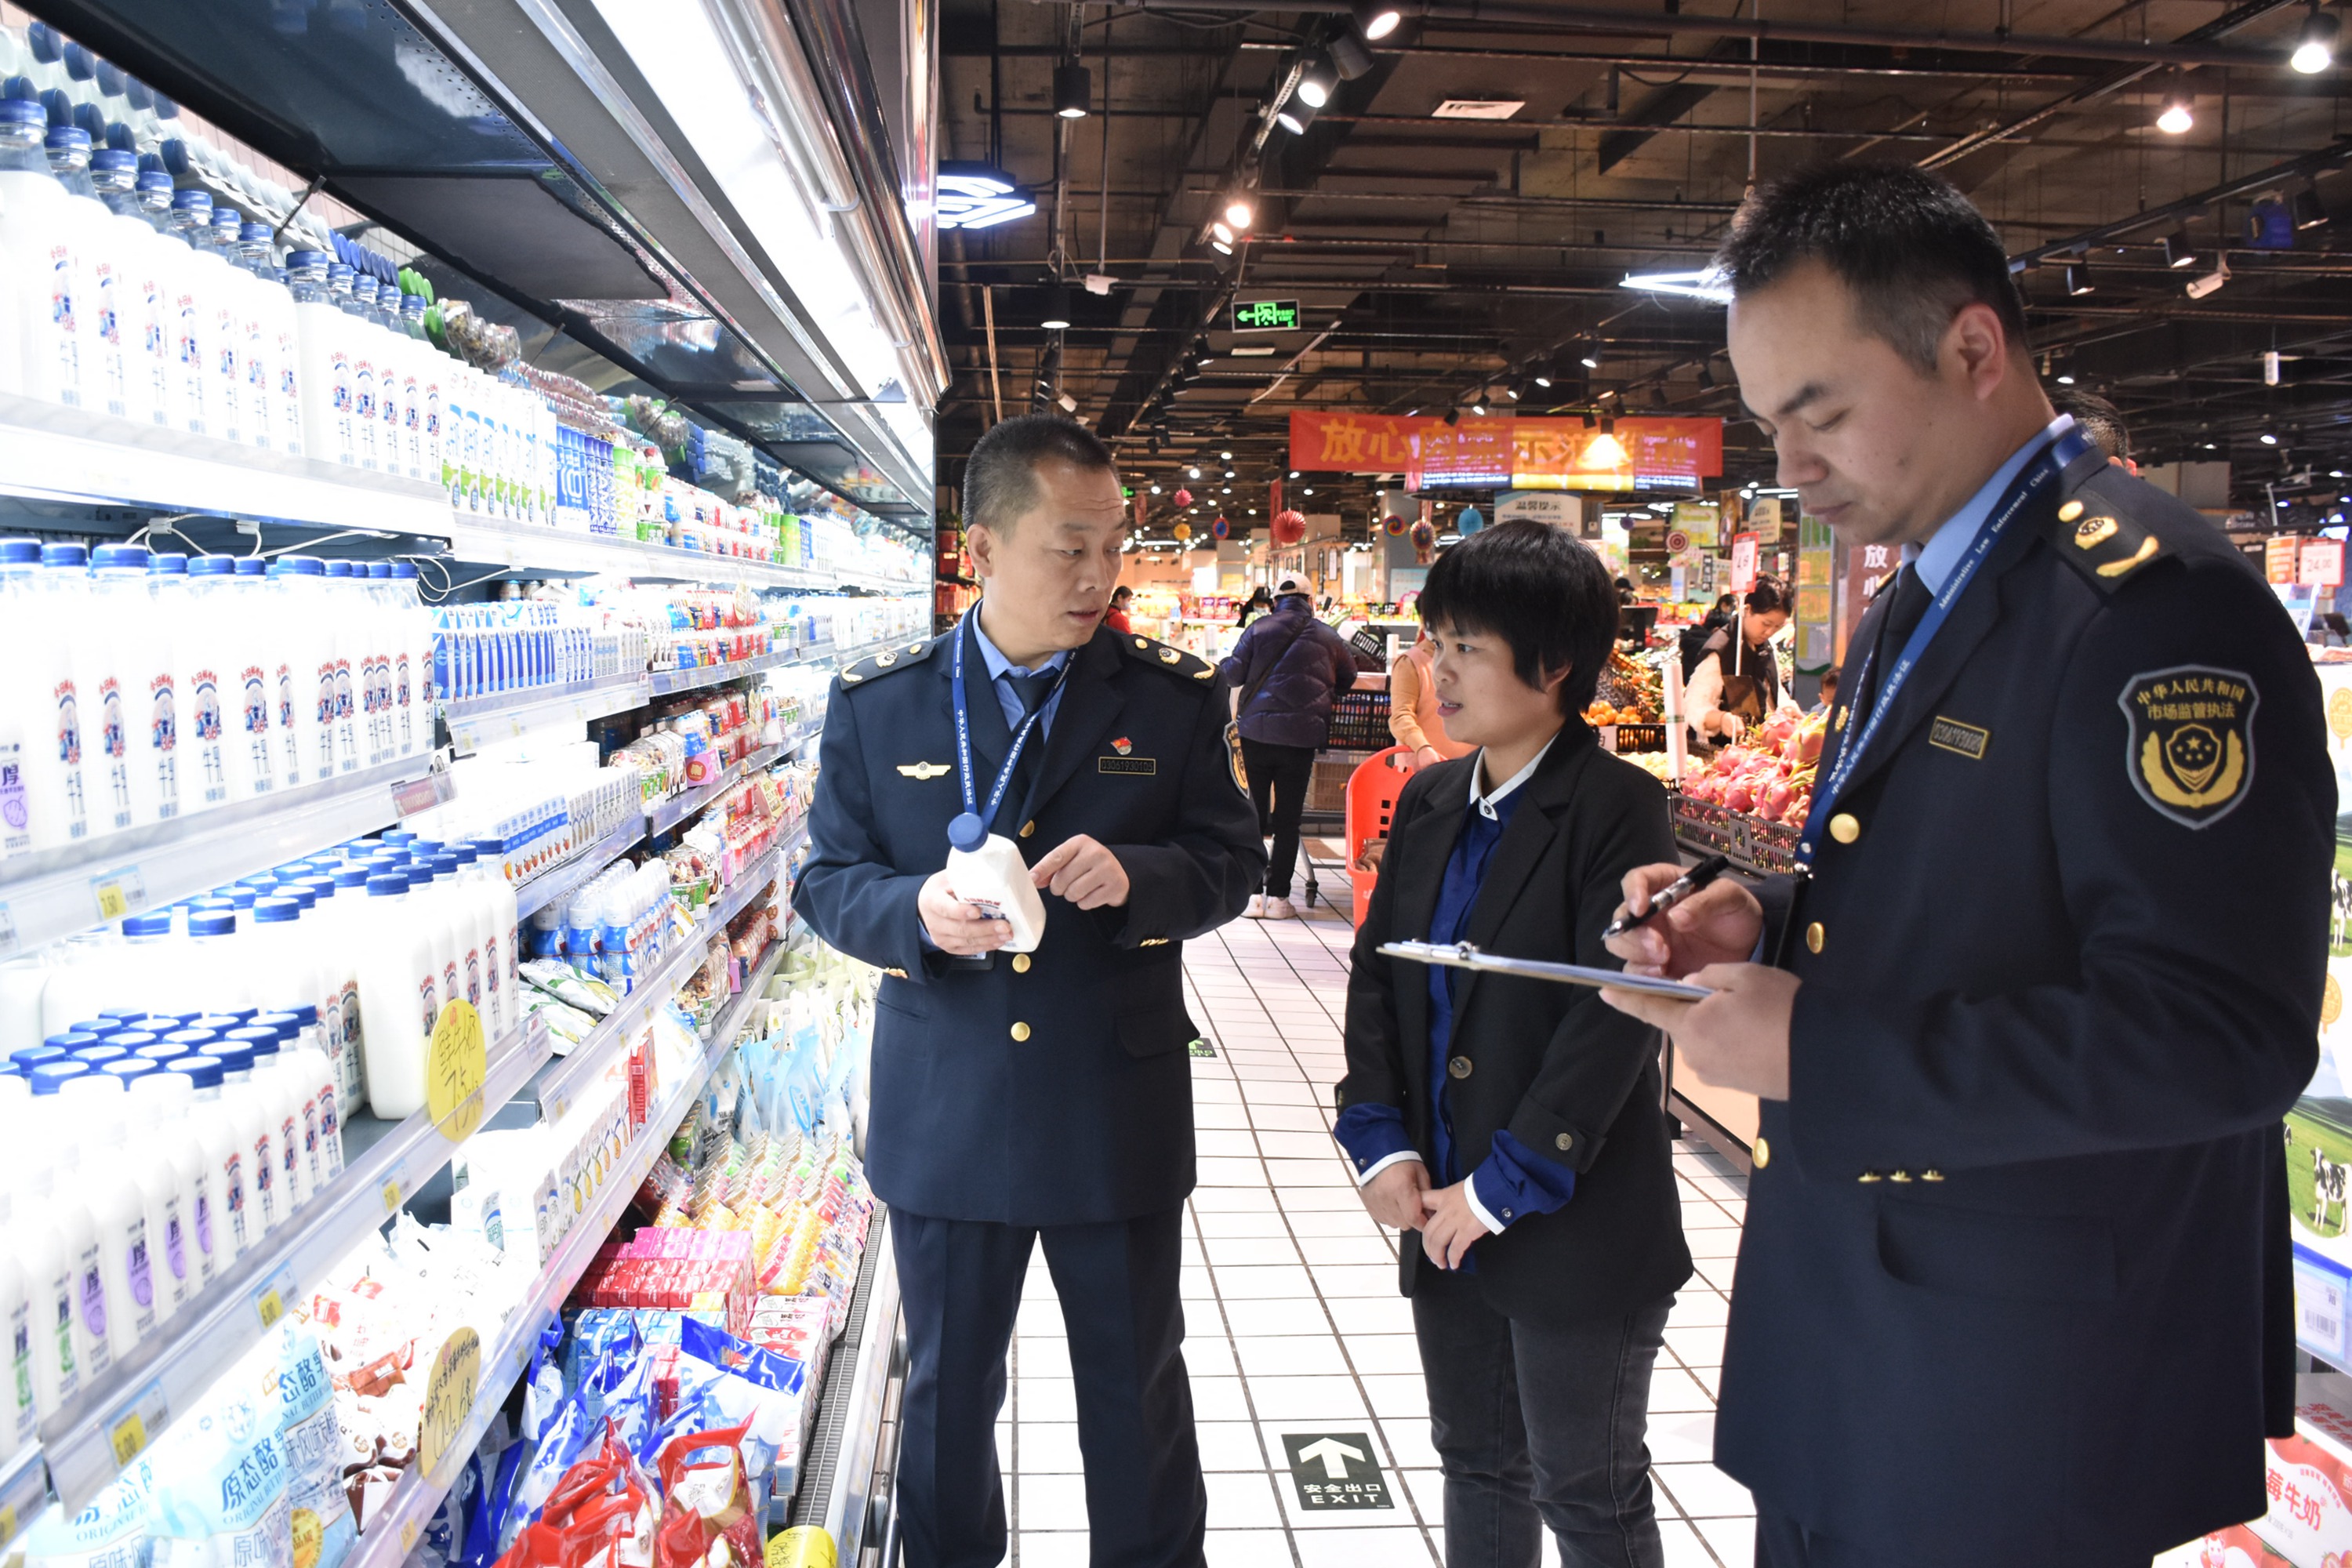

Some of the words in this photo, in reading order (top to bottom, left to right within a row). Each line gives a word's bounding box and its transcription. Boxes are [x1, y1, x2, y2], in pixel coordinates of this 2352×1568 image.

[1938, 558, 1975, 610] Administrative
[1975, 537, 1990, 555] Law
[1991, 490, 2028, 534] Enforcement
[2029, 468, 2049, 488] China
[2136, 678, 2246, 706] 中华人民共和国
[2147, 702, 2236, 720] 市场监管执法
[221, 1431, 285, 1513] 原态酪
[1304, 1483, 1382, 1494] 安全出口
[1311, 1494, 1378, 1504] EXIT
